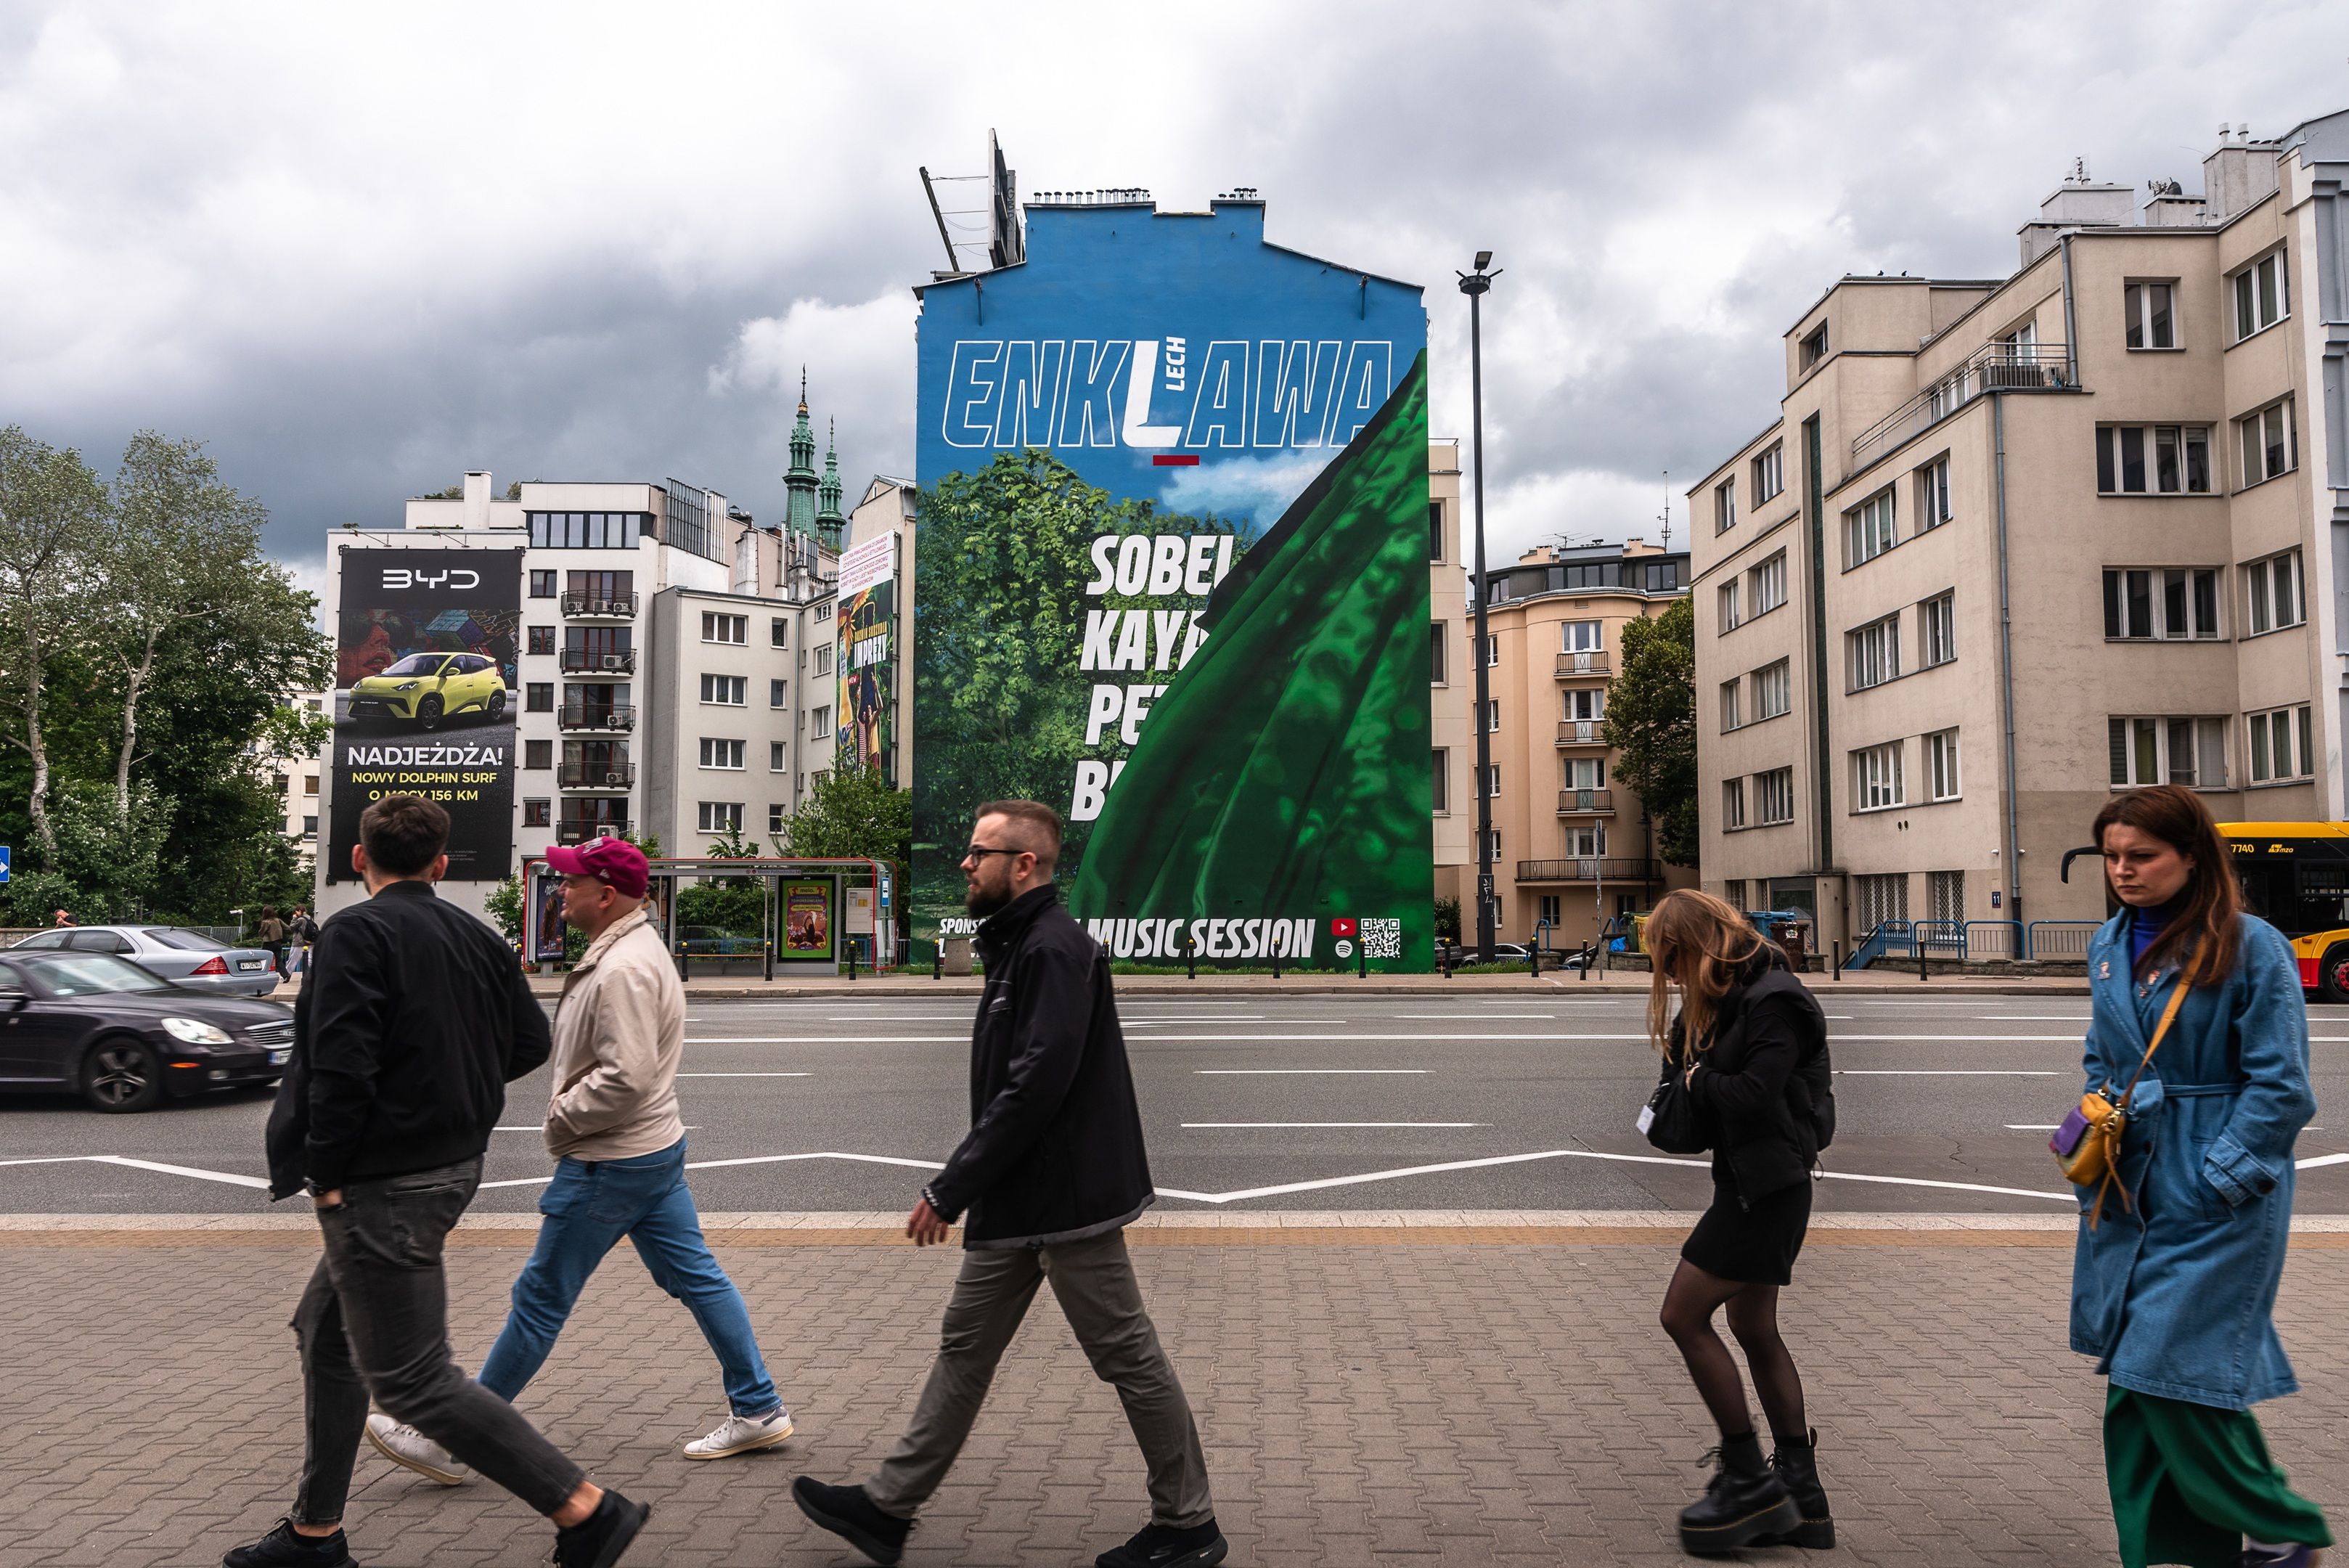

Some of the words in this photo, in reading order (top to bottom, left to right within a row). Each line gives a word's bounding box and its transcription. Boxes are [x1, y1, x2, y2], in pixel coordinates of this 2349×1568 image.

[1166, 336, 1186, 391] LECH
[943, 340, 1392, 447] ENKLAWA
[383, 569, 480, 589] BYD
[854, 633, 887, 669] IMPREZY
[1085, 684, 1169, 746] PE
[348, 741, 503, 766] NADJEŻDŻA!
[352, 772, 396, 783] NOWY
[399, 772, 458, 783] DOLPHIN
[462, 772, 497, 783] SURF
[369, 791, 380, 801] O
[430, 791, 452, 801] 156
[457, 791, 478, 801] KM
[2231, 844, 2255, 853] 7740
[1993, 895, 2000, 904] 11
[939, 918, 989, 934] SPONS
[1088, 918, 1185, 958] MUSIC
[1186, 918, 1316, 958] SESSION
